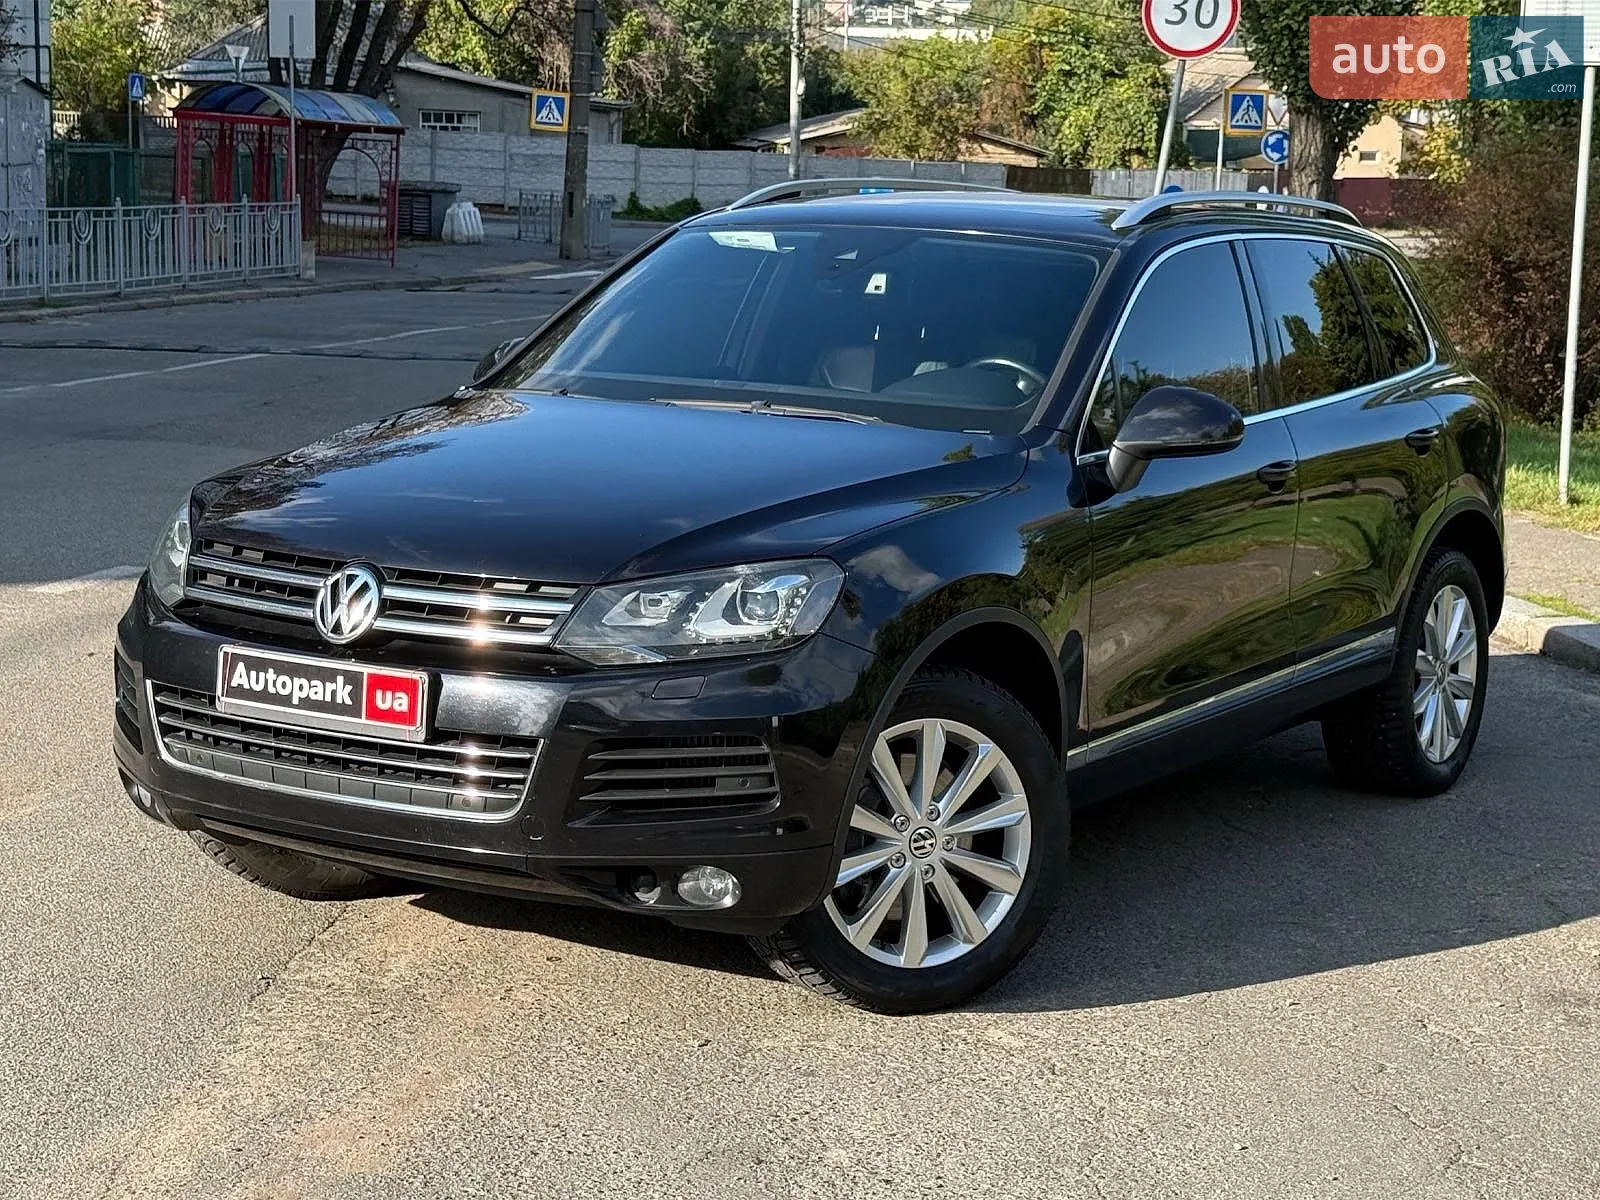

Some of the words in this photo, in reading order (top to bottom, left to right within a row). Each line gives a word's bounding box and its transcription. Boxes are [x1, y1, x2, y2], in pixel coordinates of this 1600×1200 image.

[1164, 0, 1219, 29] 30
[231, 661, 353, 705] Autopark
[375, 688, 410, 713] ua
